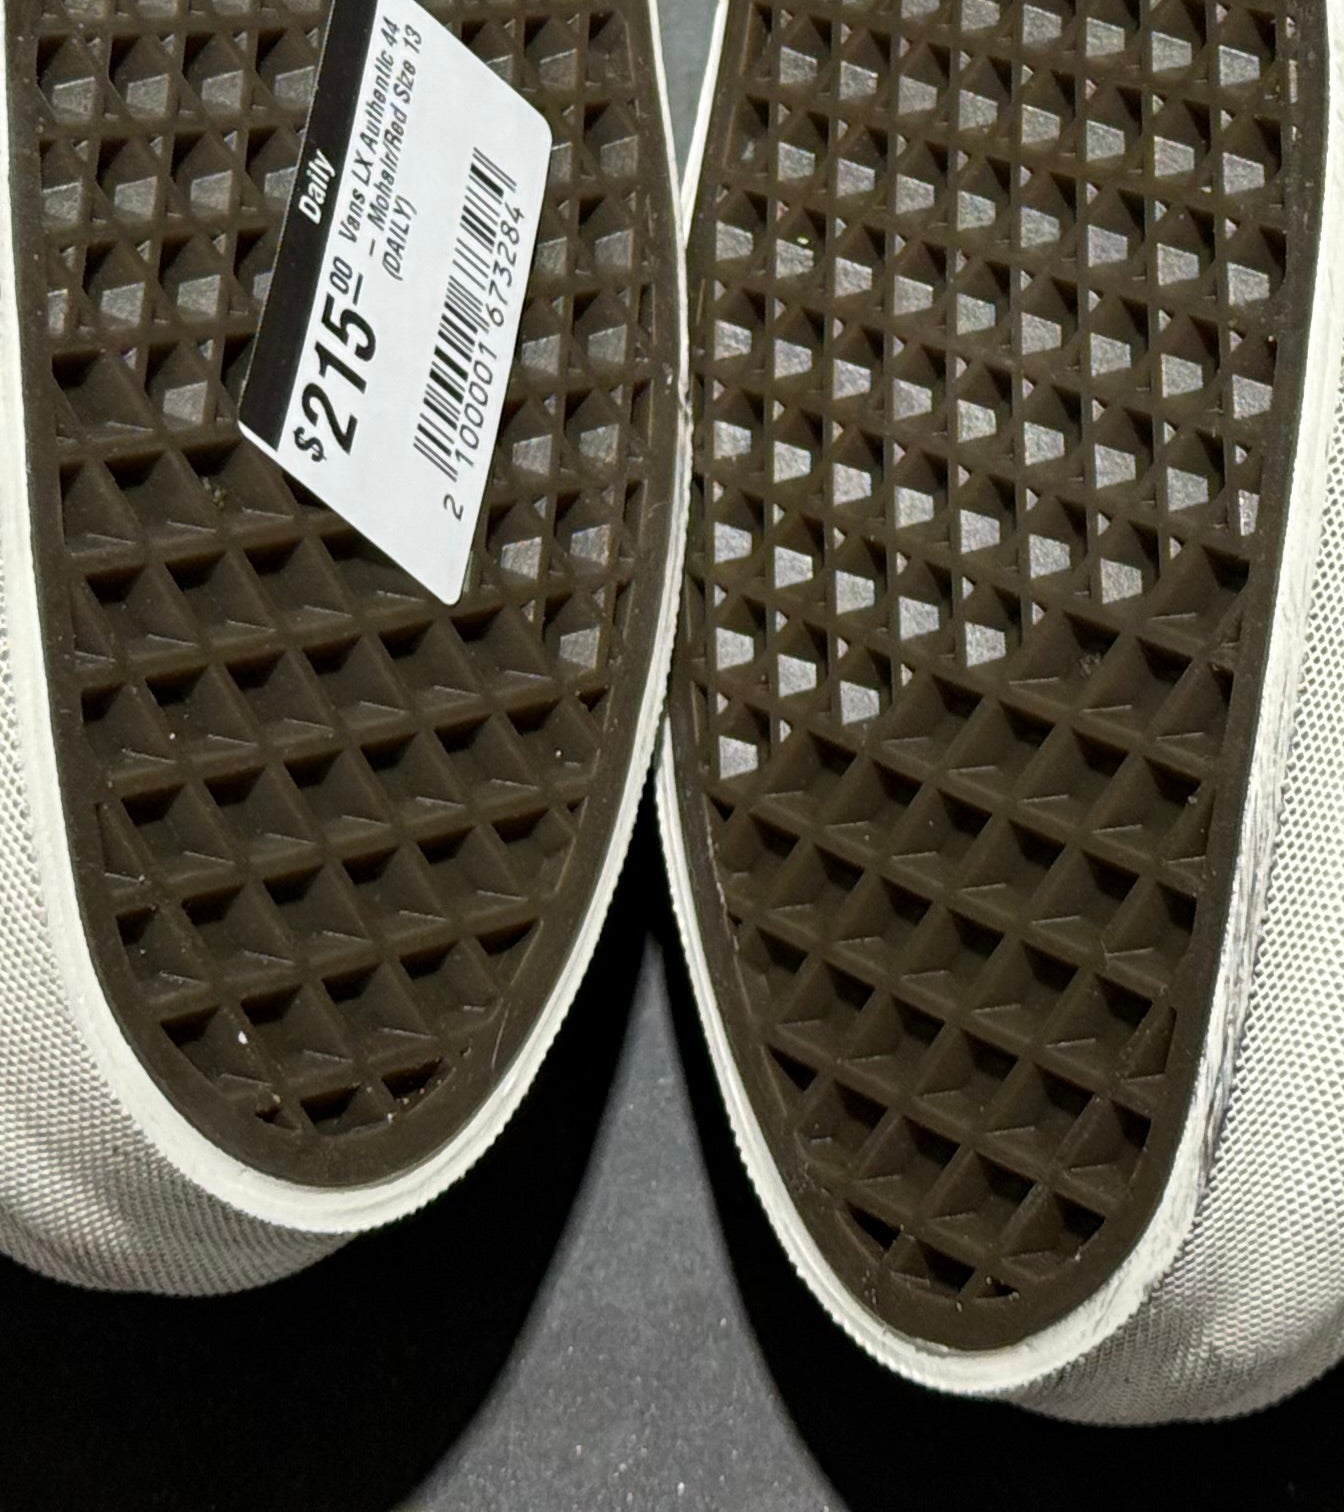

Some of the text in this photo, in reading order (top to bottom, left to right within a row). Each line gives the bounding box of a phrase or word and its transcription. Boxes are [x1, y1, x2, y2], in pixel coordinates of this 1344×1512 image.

[403, 24, 422, 53] 13
[393, 60, 416, 104] Size
[338, 16, 399, 243] Vans LX Authentic 44
[367, 103, 407, 231] Mohair/Red
[298, 149, 336, 224] Daily
[382, 195, 415, 281] (DAILY)
[454, 342, 497, 466] 100001
[485, 203, 524, 327] 673284
